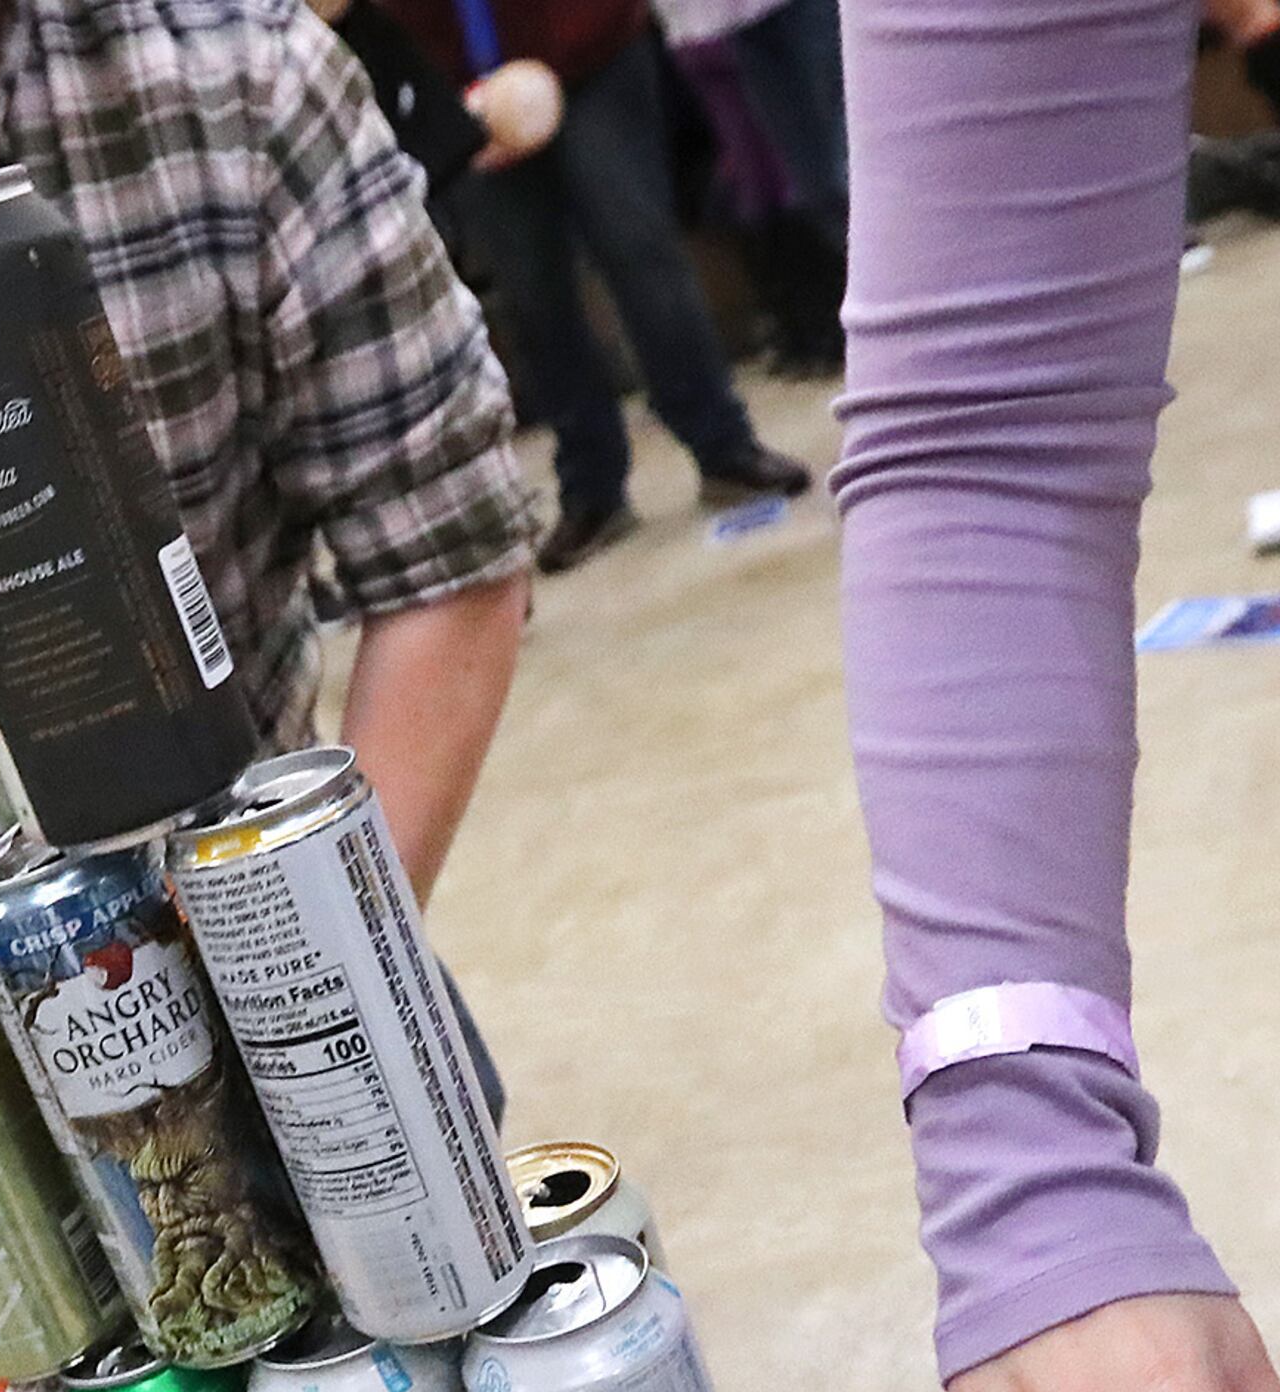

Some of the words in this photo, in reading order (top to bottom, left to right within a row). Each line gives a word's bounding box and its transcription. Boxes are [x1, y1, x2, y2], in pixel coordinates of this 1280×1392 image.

[56, 548, 85, 573] ALE
[9, 916, 83, 957] CRISP
[66, 967, 174, 1042] ANGRY
[288, 974, 346, 1003] Facts
[53, 988, 201, 1074] ORCHARD
[323, 1033, 367, 1066] 100
[89, 1060, 141, 1091] HARD
[148, 1029, 197, 1066] CIDER
